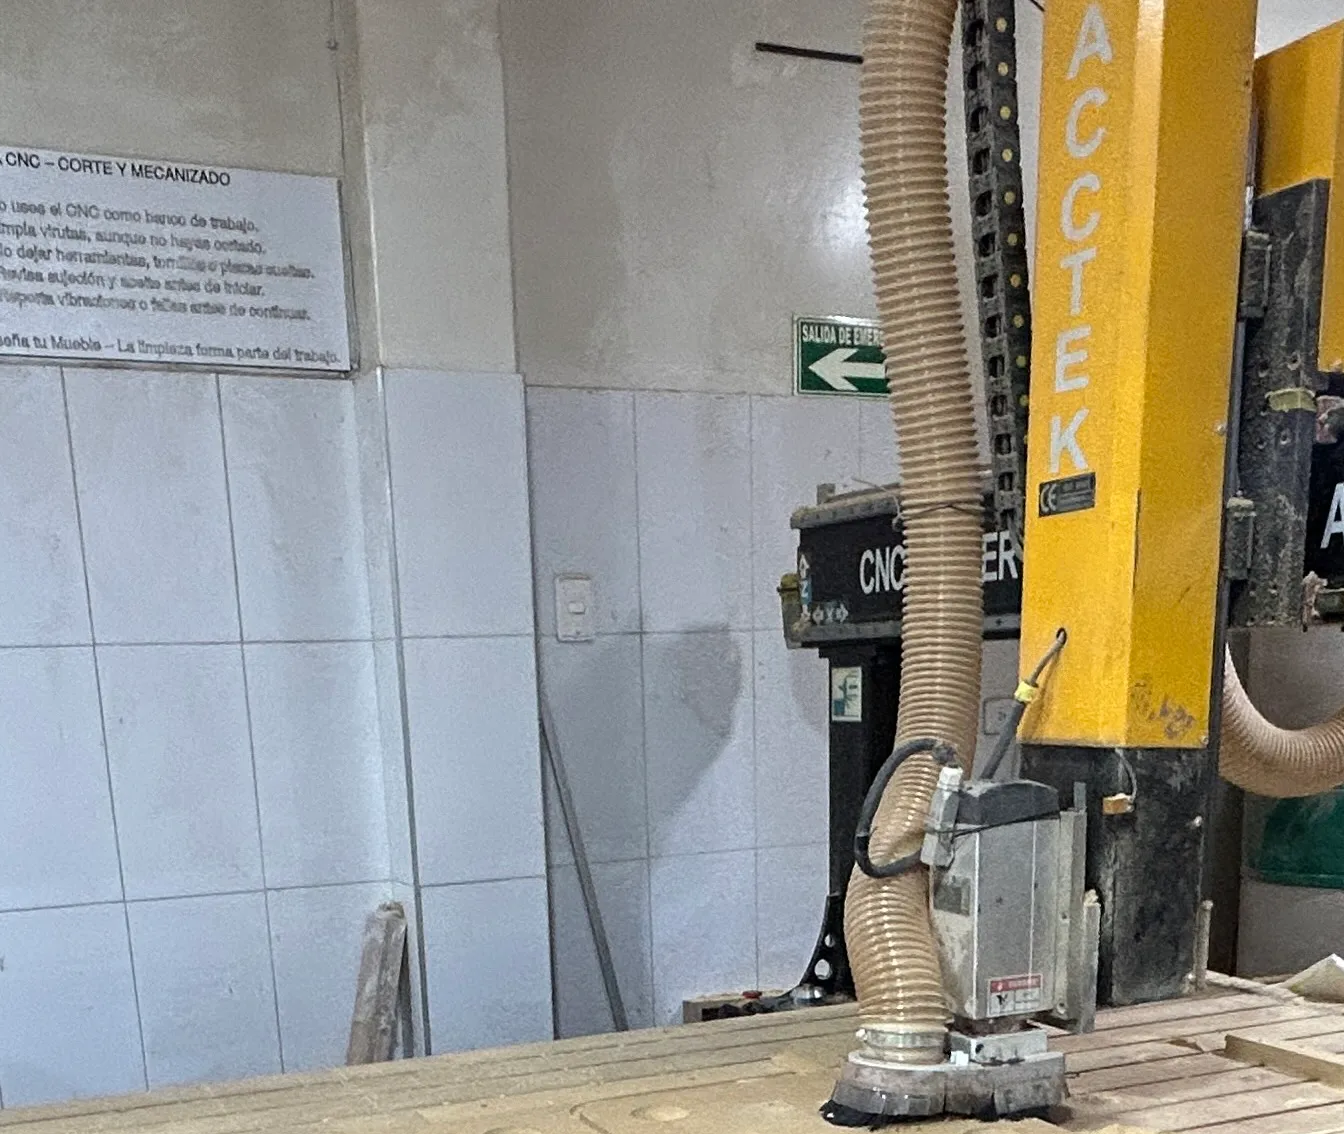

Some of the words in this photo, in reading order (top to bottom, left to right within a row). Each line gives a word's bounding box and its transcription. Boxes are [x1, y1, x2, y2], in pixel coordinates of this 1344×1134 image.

[5, 151, 41, 169] CNC
[57, 156, 113, 176] CORTE
[115, 163, 127, 177] Y
[131, 164, 231, 186] MECANIZADO
[50, 202, 61, 216] el
[65, 203, 100, 219] CNC
[103, 208, 141, 223] como
[145, 209, 187, 226] banco
[190, 213, 207, 228] de
[95, 231, 147, 248] aunque
[150, 236, 167, 246] no
[1047, 2, 1114, 474] ACCTEK
[107, 276, 116, 290] y
[204, 279, 221, 294] de
[139, 300, 148, 311] o
[228, 303, 246, 317] de
[32, 334, 47, 349] tu
[117, 338, 135, 354] La
[137, 339, 194, 359] limpieza
[196, 343, 235, 358] forma
[236, 346, 270, 361] parte
[273, 347, 292, 361] del
[802, 324, 836, 343] SALIDA
[838, 326, 852, 346] DE
[859, 543, 906, 595] CNC
